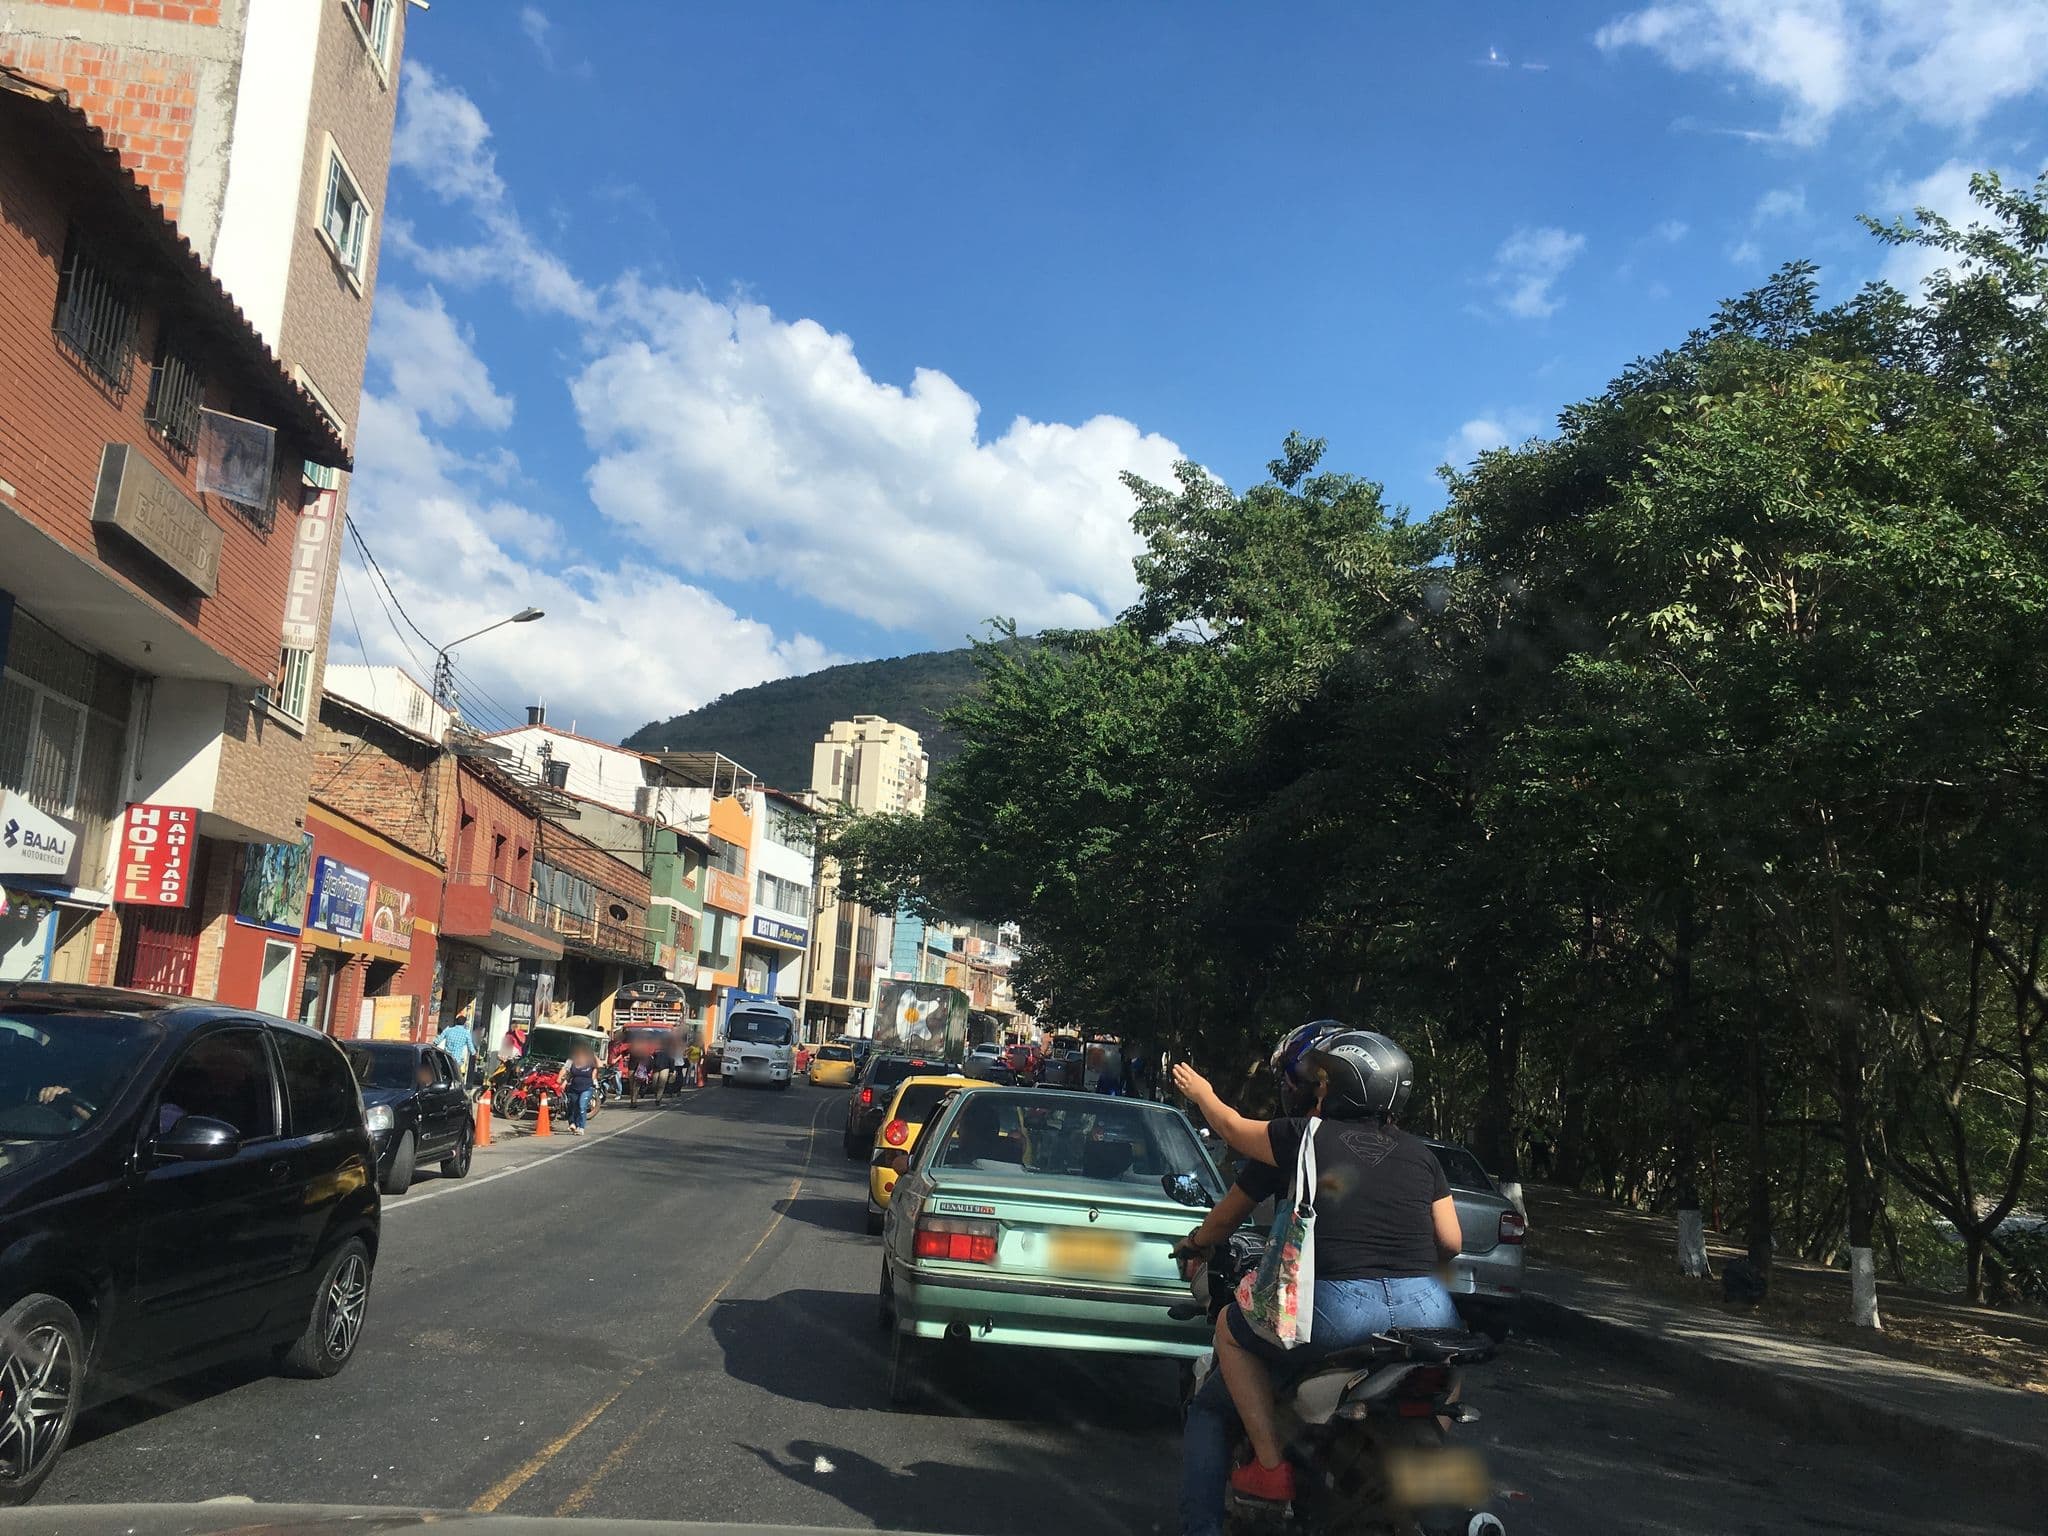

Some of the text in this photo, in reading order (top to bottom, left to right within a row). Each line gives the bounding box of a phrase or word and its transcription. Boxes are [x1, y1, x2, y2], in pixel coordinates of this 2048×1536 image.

[152, 477, 208, 545] HOTEL
[289, 492, 331, 621] HOTEL
[21, 848, 65, 866] MOTORCYCLES
[23, 830, 67, 855] BAJAJ
[124, 808, 160, 900] HOTEL
[159, 811, 190, 903] EL AHIJADO
[941, 1203, 973, 1212] RENAULT
